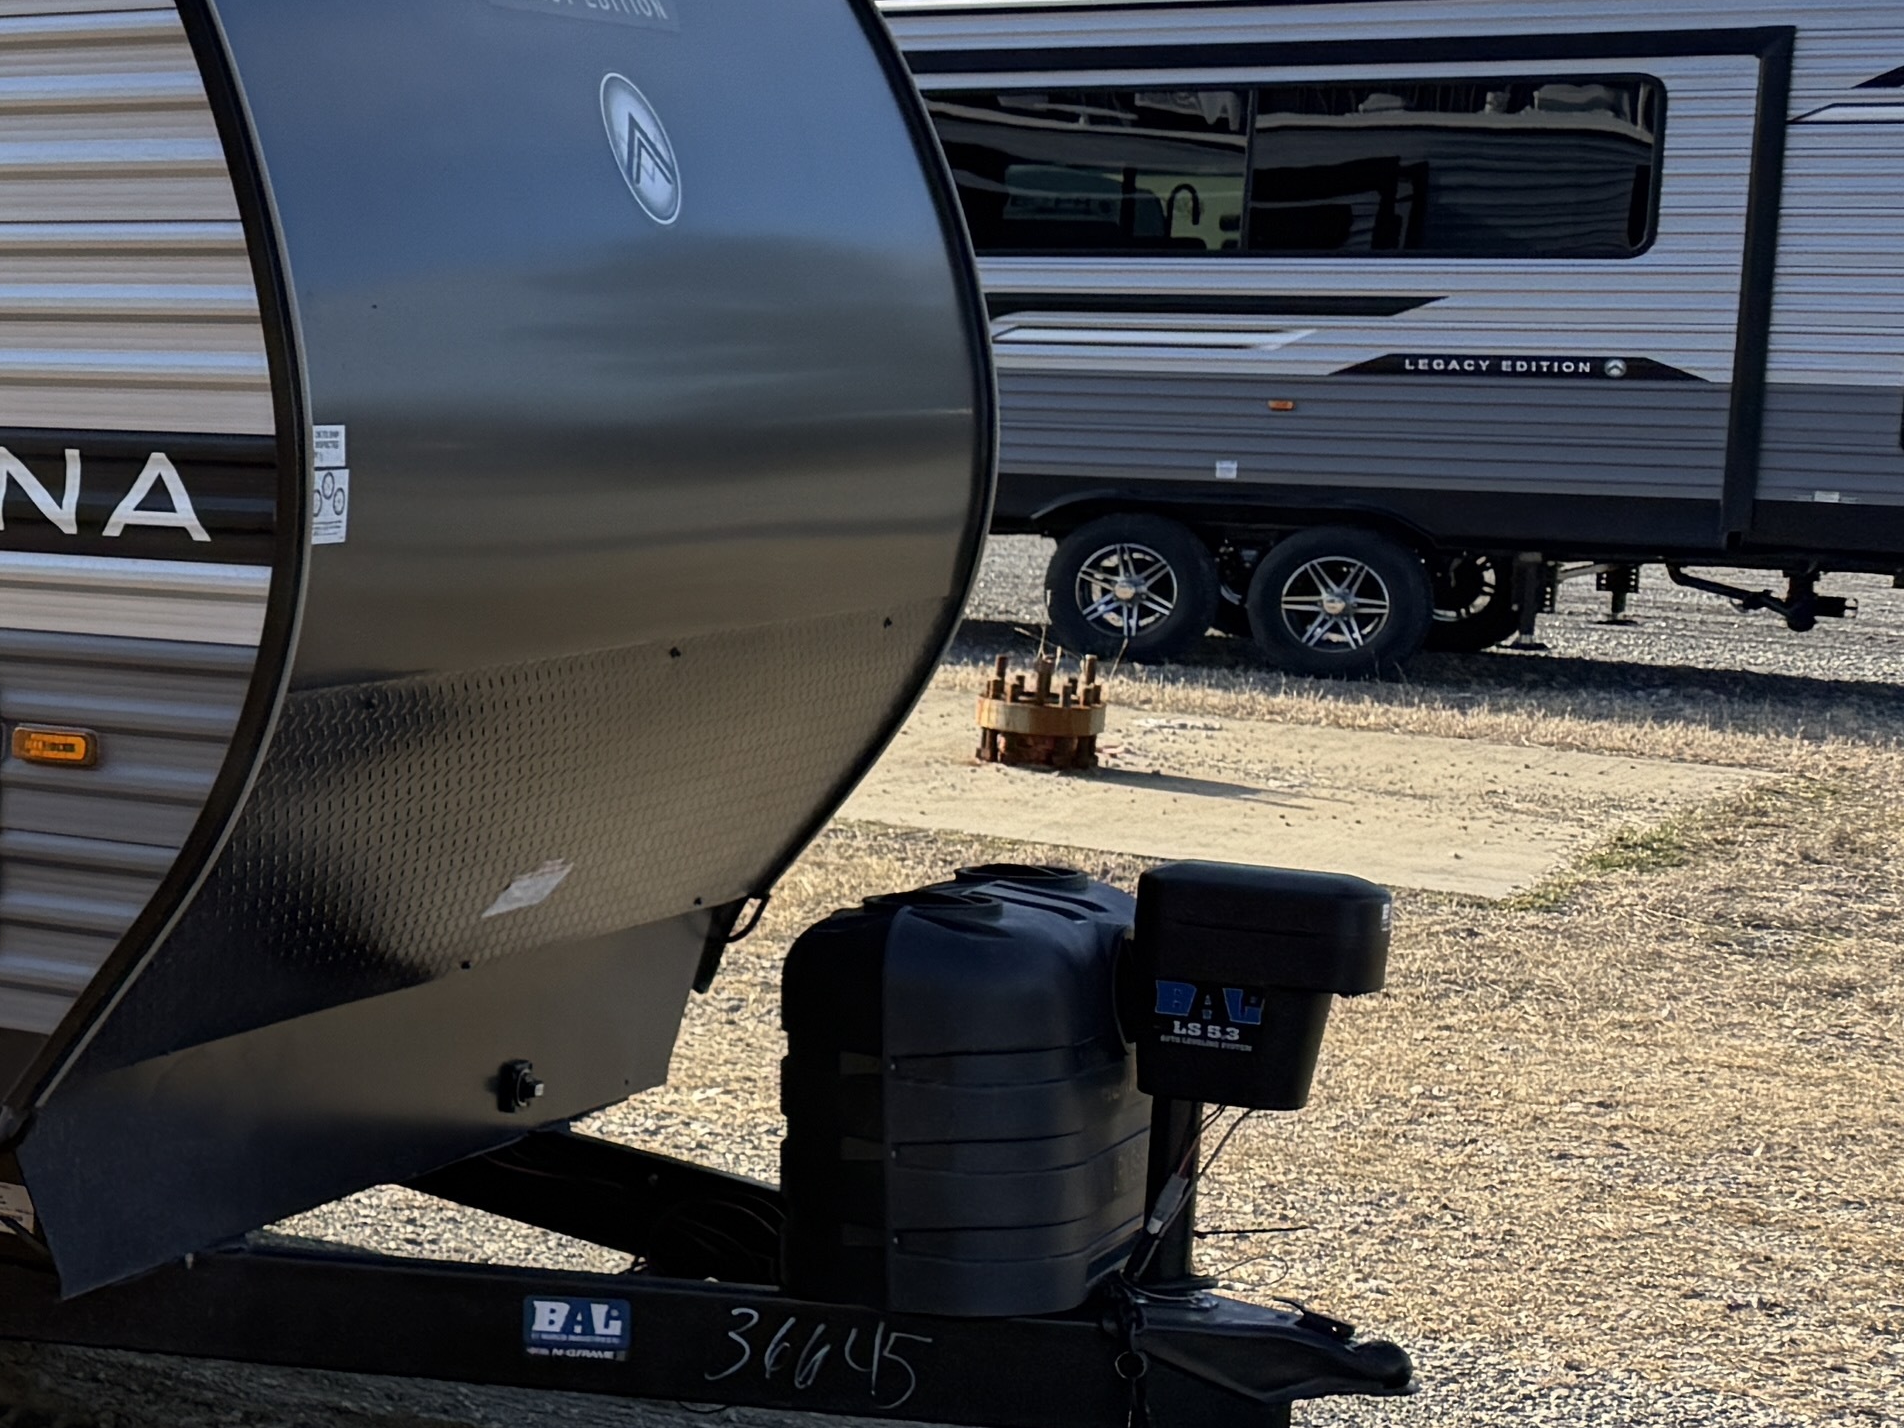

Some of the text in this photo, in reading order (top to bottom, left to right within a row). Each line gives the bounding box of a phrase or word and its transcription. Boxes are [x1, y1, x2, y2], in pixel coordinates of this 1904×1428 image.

[1404, 358, 1591, 373] LEGACY EDITION
[1154, 979, 1266, 1025] BAL
[1173, 1020, 1240, 1041] LS 5.3
[532, 1300, 622, 1336] BAL
